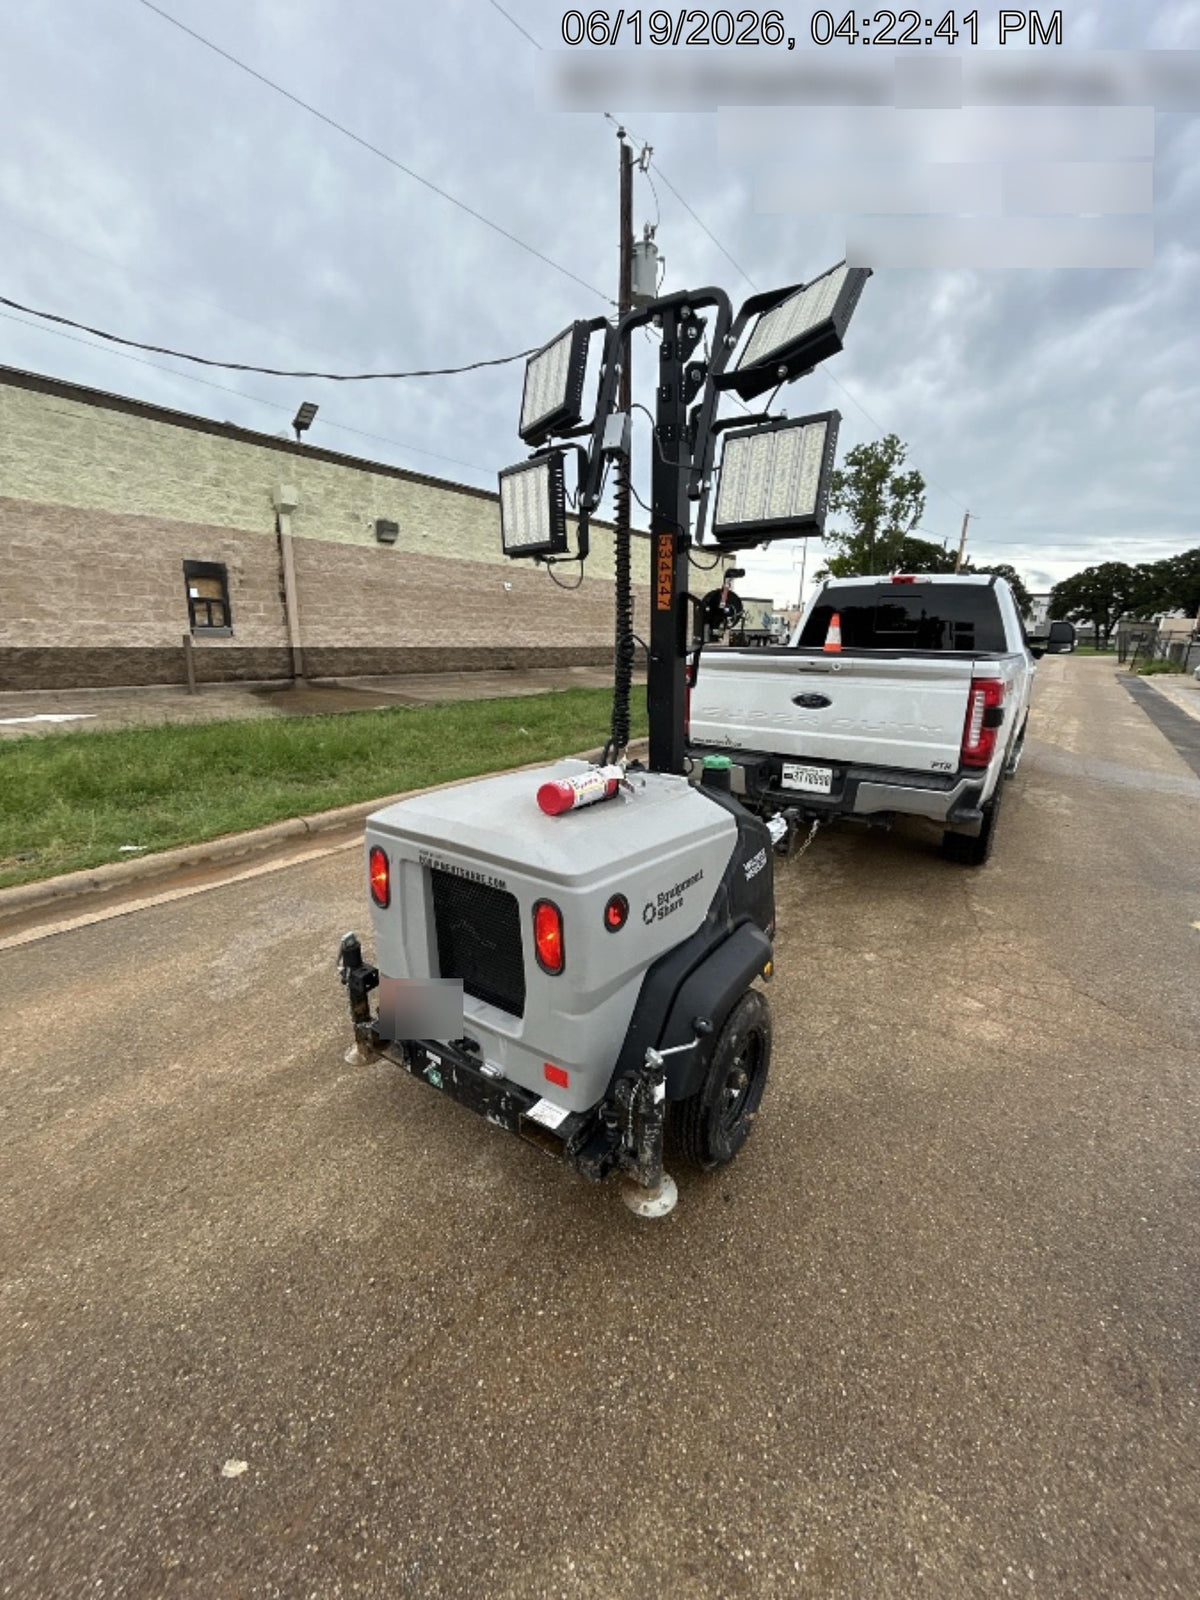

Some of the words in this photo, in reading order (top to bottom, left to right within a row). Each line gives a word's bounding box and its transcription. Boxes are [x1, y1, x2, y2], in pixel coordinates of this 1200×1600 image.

[659, 536, 672, 608] 534547
[656, 868, 704, 907] Equipment
[656, 897, 684, 921] Share
